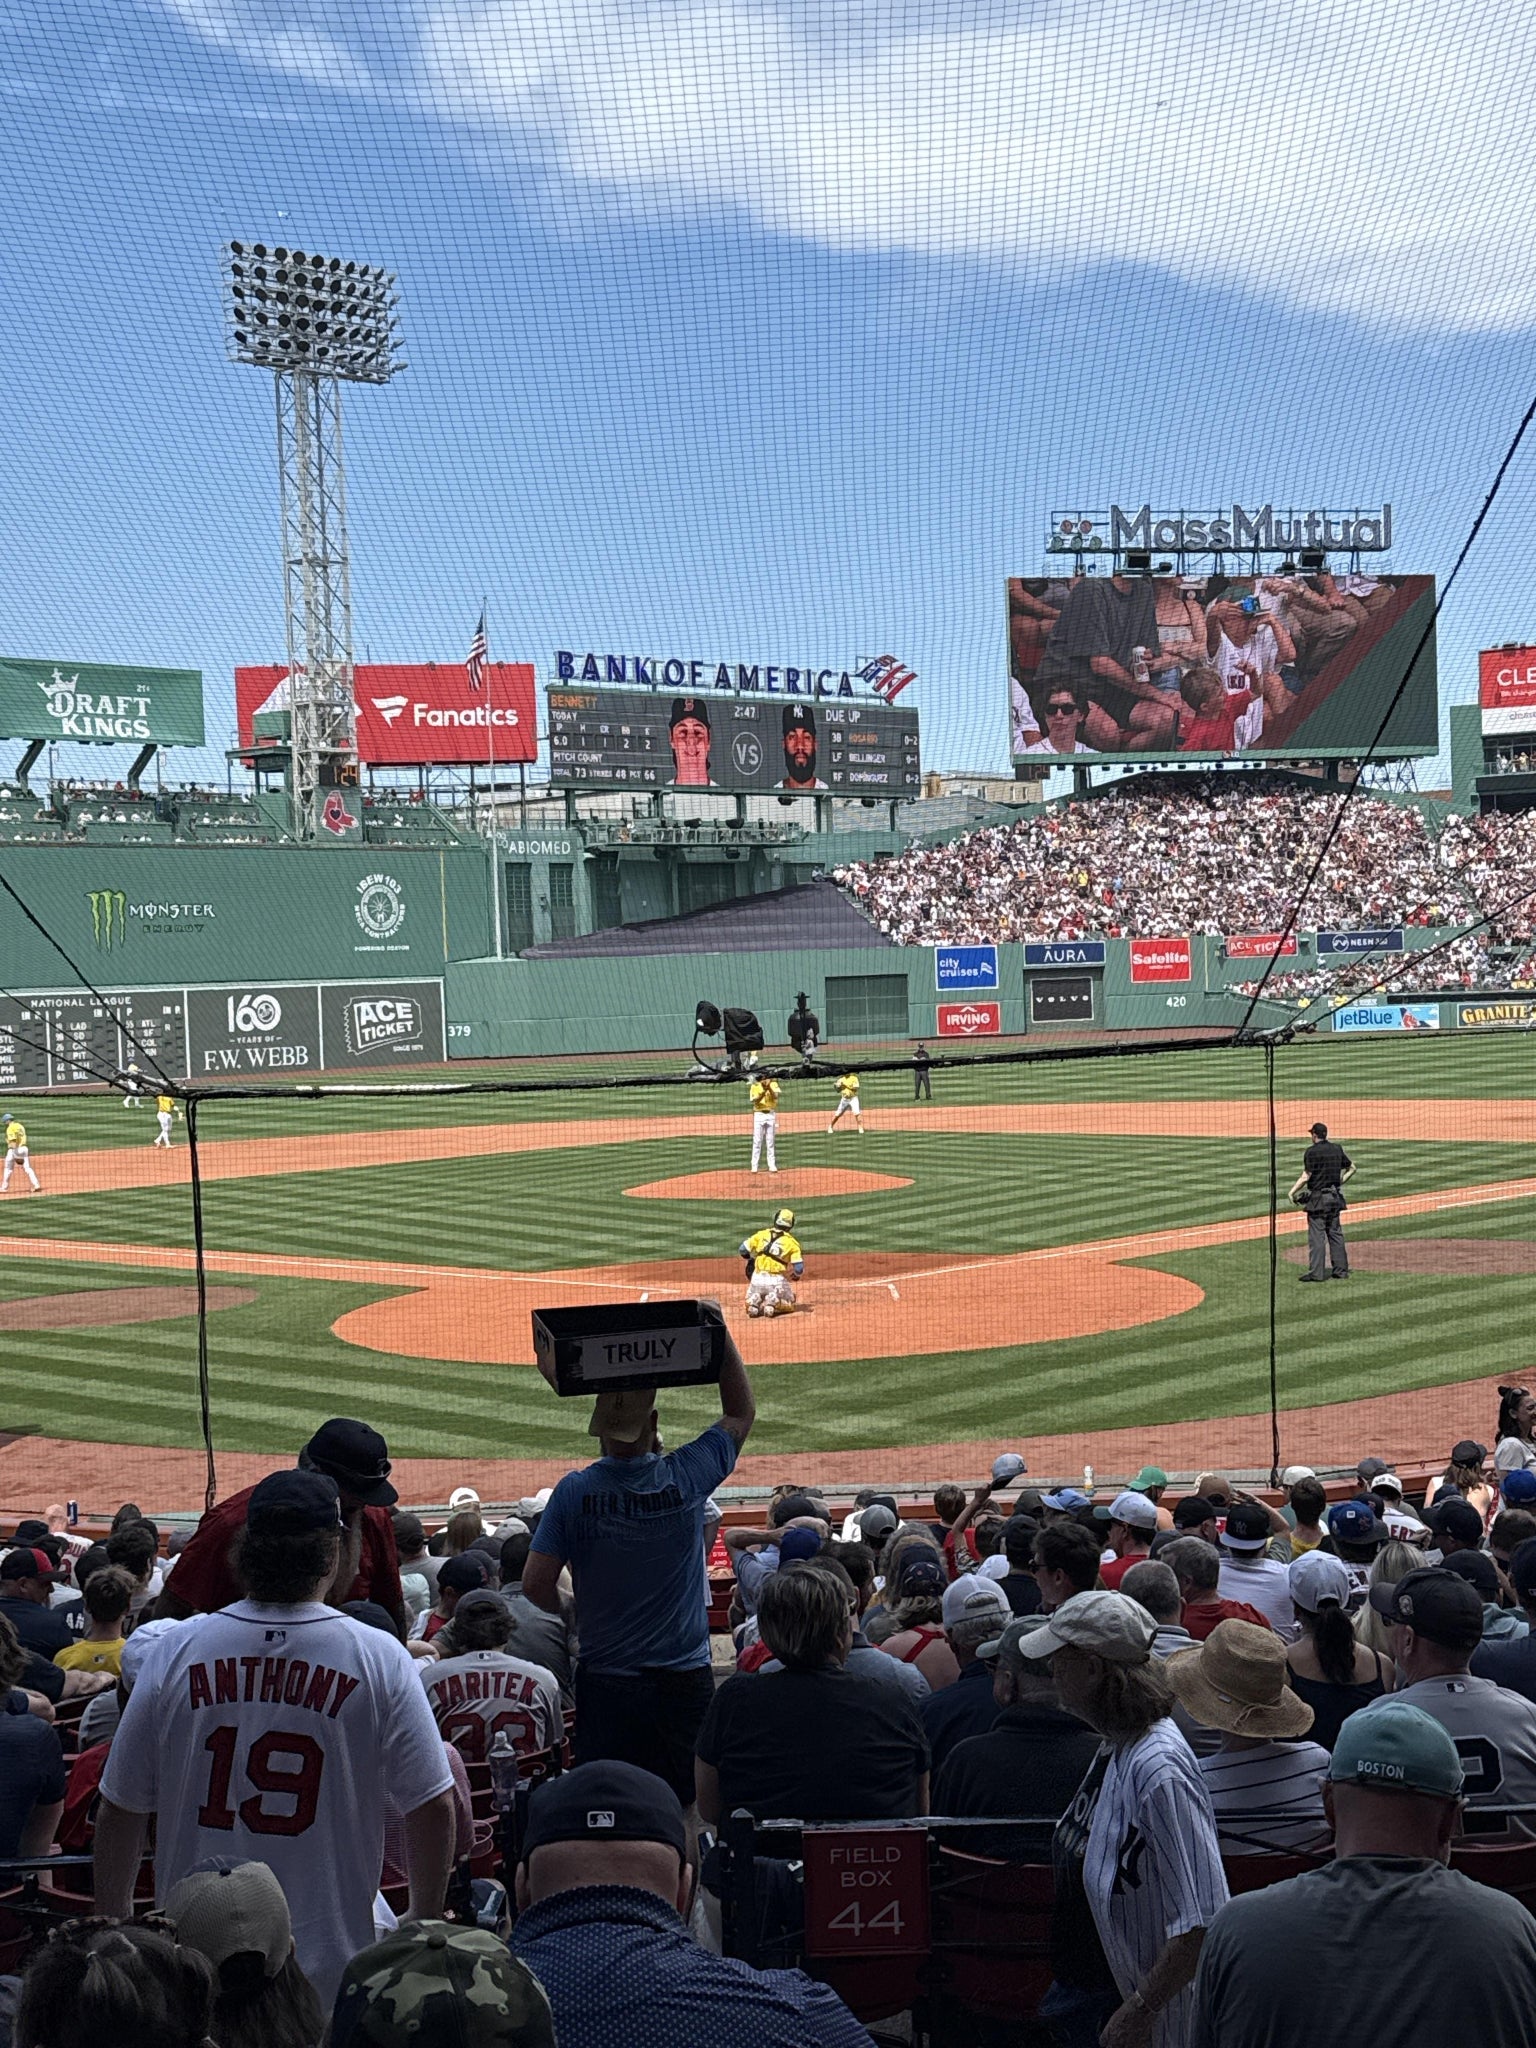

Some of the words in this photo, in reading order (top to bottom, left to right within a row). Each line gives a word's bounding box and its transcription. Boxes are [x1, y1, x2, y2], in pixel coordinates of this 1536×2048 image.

[1110, 503, 1392, 551] MassMutual
[555, 650, 652, 684] BANK
[663, 658, 703, 687] OF
[714, 662, 854, 698] AMERICA
[45, 691, 151, 718] DRAFT
[550, 694, 598, 709] BENNETT
[413, 703, 519, 727] Fanatics
[551, 711, 578, 721] TODAY
[734, 705, 756, 718] 2:47
[825, 709, 845, 723] DUE
[848, 711, 861, 723] UP
[61, 713, 151, 739] KINGS
[553, 736, 568, 746] 6.0
[623, 738, 630, 749] 2
[645, 739, 651, 750] 2
[552, 752, 576, 762] PITCH
[577, 753, 603, 763] COUNT
[735, 743, 759, 765] VS
[574, 767, 587, 778] 73
[615, 769, 626, 780] 48
[643, 769, 656, 781] 66
[508, 841, 571, 855] ABIOMED
[355, 873, 384, 894] IBEW
[384, 875, 402, 895] 103
[129, 902, 216, 920] MONSTER
[143, 923, 205, 934] ENERGY
[939, 957, 960, 970] city
[1132, 951, 1189, 965] Safelite
[939, 966, 979, 978] cruises
[31, 998, 85, 1008] NATIONAL
[89, 996, 132, 1006] LEAGUE
[1035, 994, 1090, 1004] VOLVO
[1166, 996, 1187, 1008] 420
[227, 994, 282, 1033] 160
[358, 1000, 414, 1027] ACE
[946, 1012, 991, 1026] IRVING
[1339, 1009, 1393, 1029] jetBlue
[1462, 1005, 1528, 1024] GRANITE
[70, 1021, 87, 1031] LAD
[141, 1019, 156, 1028] ATL
[361, 1020, 415, 1043] TICKET
[447, 1024, 472, 1038] 379
[203, 1049, 242, 1071] F.W.
[243, 1045, 310, 1068] WEBB
[602, 1337, 677, 1365] TRULY
[188, 1656, 360, 1720] ANTHONY
[433, 1671, 539, 1707] VARITEK
[1357, 1760, 1405, 1779] BOSTON
[198, 1725, 325, 1837] 19
[830, 1846, 901, 1865] FIELD
[840, 1870, 893, 1888] BOX
[827, 1899, 906, 1937] 44
